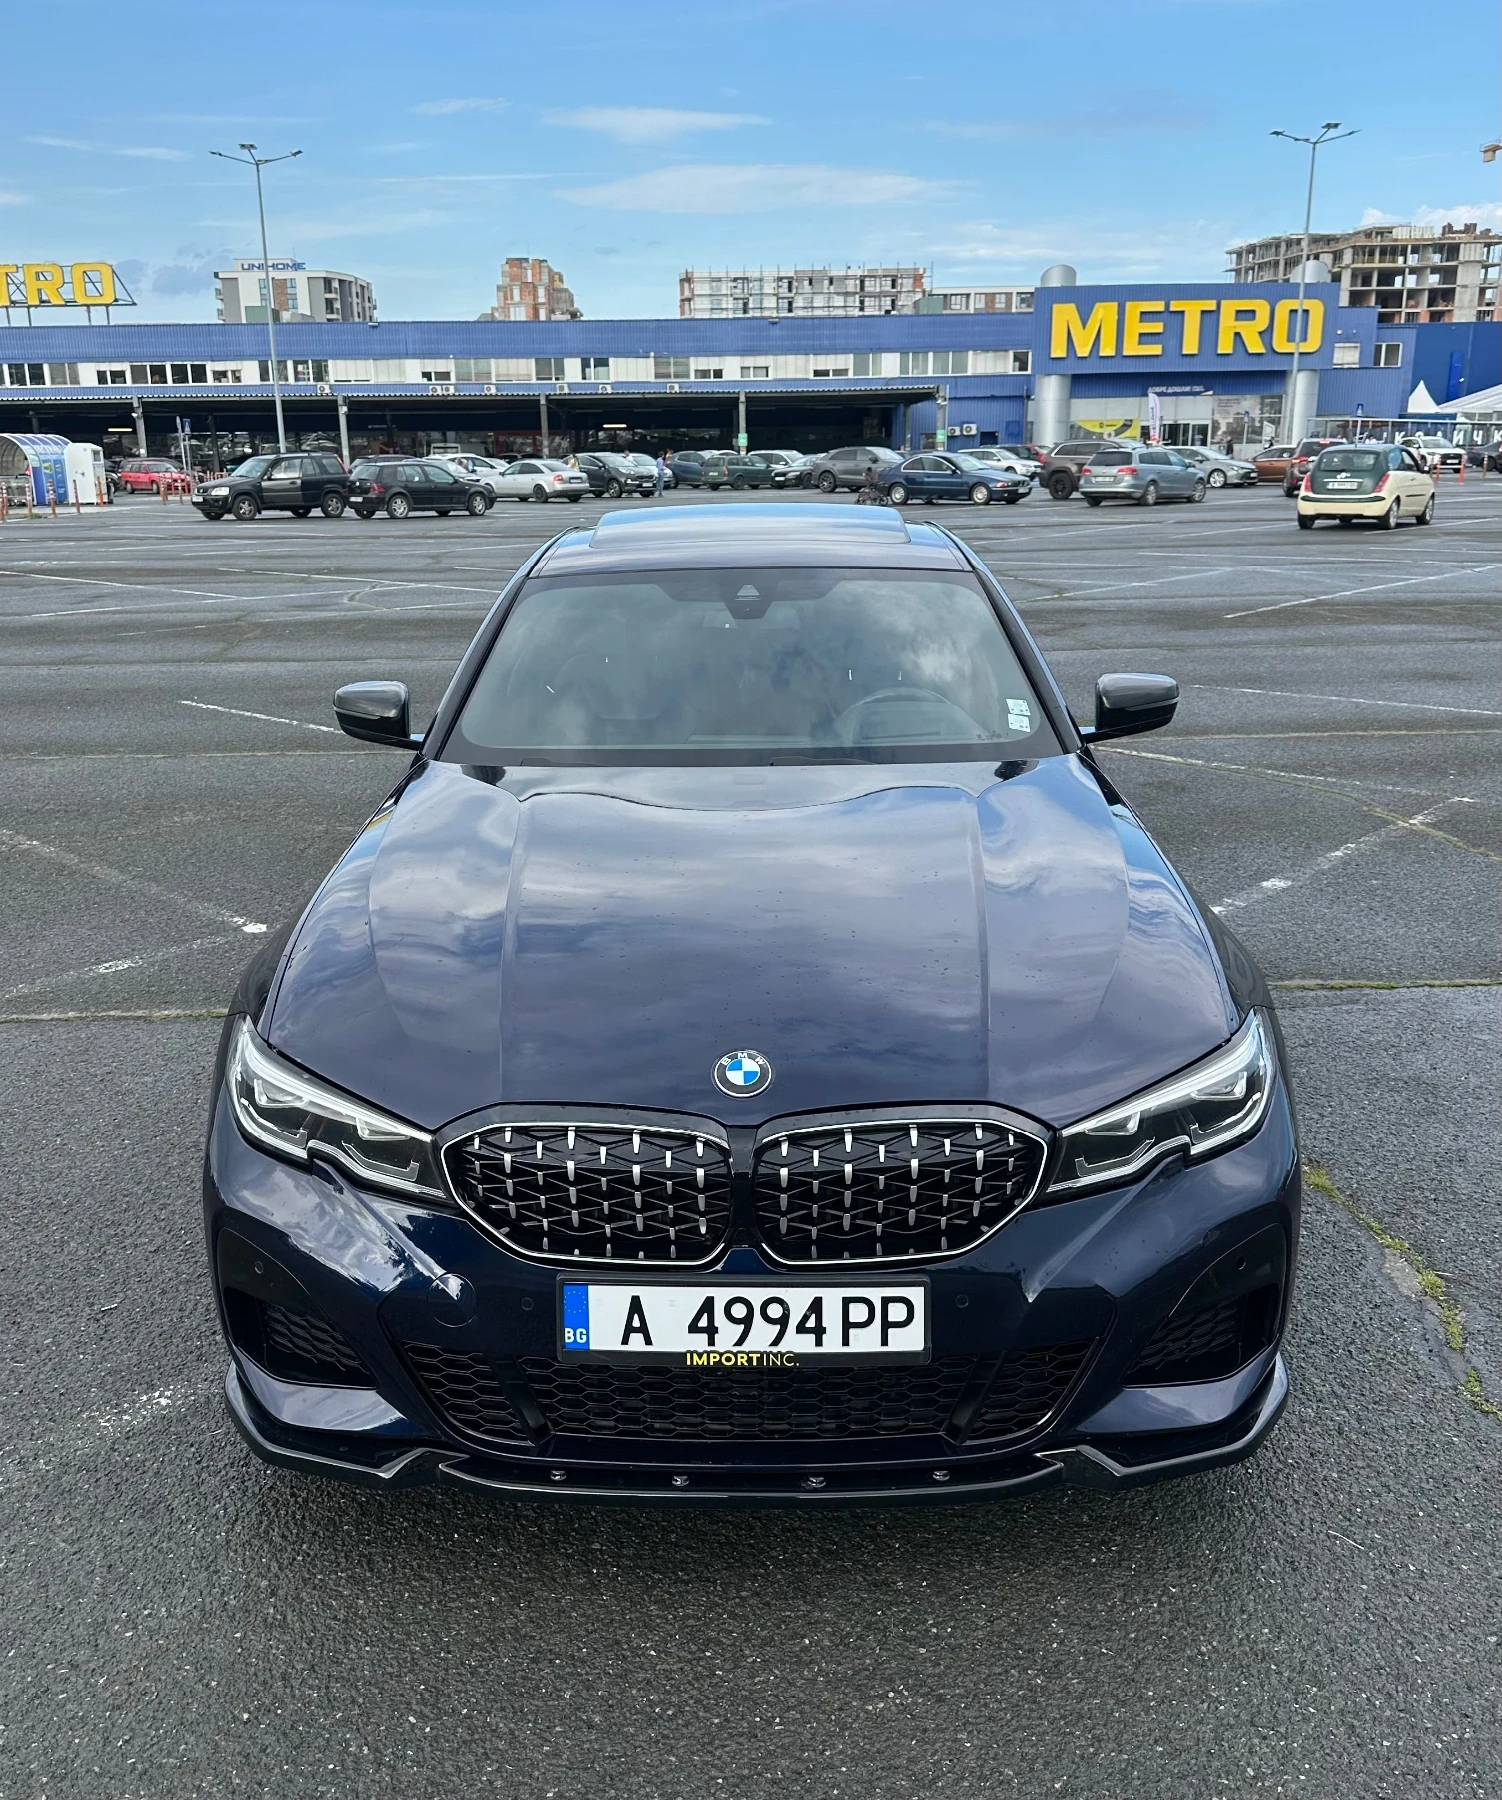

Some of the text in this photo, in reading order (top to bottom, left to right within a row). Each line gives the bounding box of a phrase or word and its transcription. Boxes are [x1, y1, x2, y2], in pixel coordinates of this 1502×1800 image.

[241, 262, 306, 271] UNIHOME
[1050, 299, 1324, 358] METRO
[720, 1052, 766, 1066] BMW
[564, 1327, 587, 1344] BG
[620, 1295, 653, 1346] A
